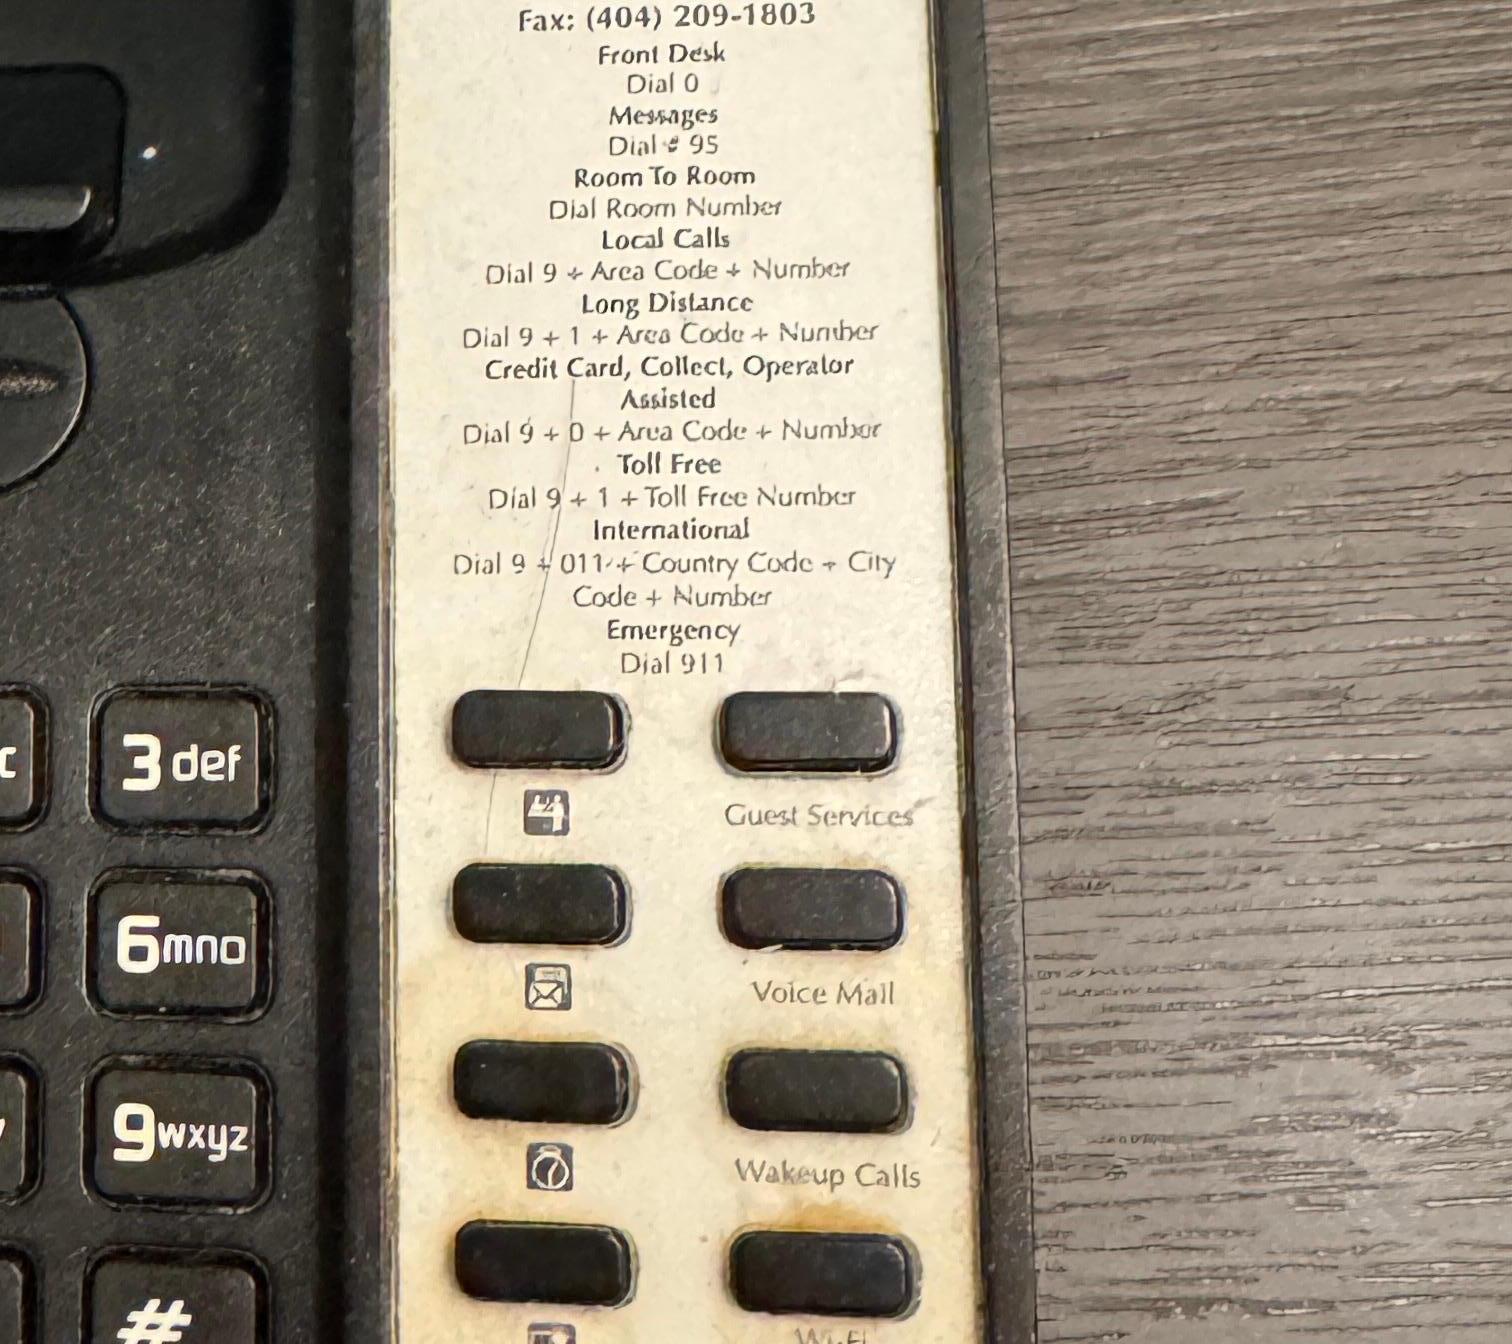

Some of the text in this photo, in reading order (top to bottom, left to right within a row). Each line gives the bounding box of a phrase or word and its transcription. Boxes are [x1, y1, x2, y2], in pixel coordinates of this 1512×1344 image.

[519, 2, 815, 32] Fax: (404) 209-1803
[599, 42, 726, 65] Front Desk
[627, 72, 699, 94] Dial 0
[609, 105, 718, 130] Messages
[609, 134, 656, 156] Dial
[689, 135, 718, 154] 95
[574, 166, 756, 189] Room To Room
[550, 195, 782, 220] Dial Room Number
[602, 227, 730, 250] Local Calls
[486, 264, 532, 285] Dial
[543, 263, 557, 283] 9
[591, 262, 645, 281] Area
[655, 260, 718, 280] Code
[752, 258, 850, 279] Number
[582, 291, 753, 319] Long Distance
[463, 325, 509, 349] Dial
[519, 328, 532, 347] 9
[572, 326, 578, 345] 1
[616, 326, 671, 344] Area
[680, 322, 744, 343] Code
[779, 319, 879, 341] Number
[485, 354, 854, 382] Credit Card, Collect, Operator
[620, 388, 716, 410] Assisted
[463, 420, 509, 444] Dial
[519, 418, 532, 442] 9
[570, 422, 583, 442] 0
[618, 421, 673, 441] Area
[683, 418, 747, 440] Code
[782, 418, 882, 439] Number
[617, 453, 722, 474] Toll Free
[489, 486, 536, 509] Dial
[546, 489, 561, 509] 9
[599, 489, 608, 507] 1
[644, 485, 686, 507] Toll
[698, 488, 748, 507] Free
[757, 485, 856, 507] Number
[593, 518, 749, 540] International
[453, 552, 501, 574] Dial
[512, 554, 525, 574] 9
[561, 554, 602, 574] 011
[643, 552, 738, 580] Country
[748, 552, 814, 572] Code
[848, 551, 896, 578] City
[573, 585, 636, 607] Code
[673, 587, 772, 608] Number
[608, 621, 741, 646] Emergency
[622, 652, 723, 675] Dial 911
[725, 803, 914, 828] Guest Services
[752, 981, 895, 1006] Voice Mail
[735, 1159, 921, 1189] Wakeup Calls
